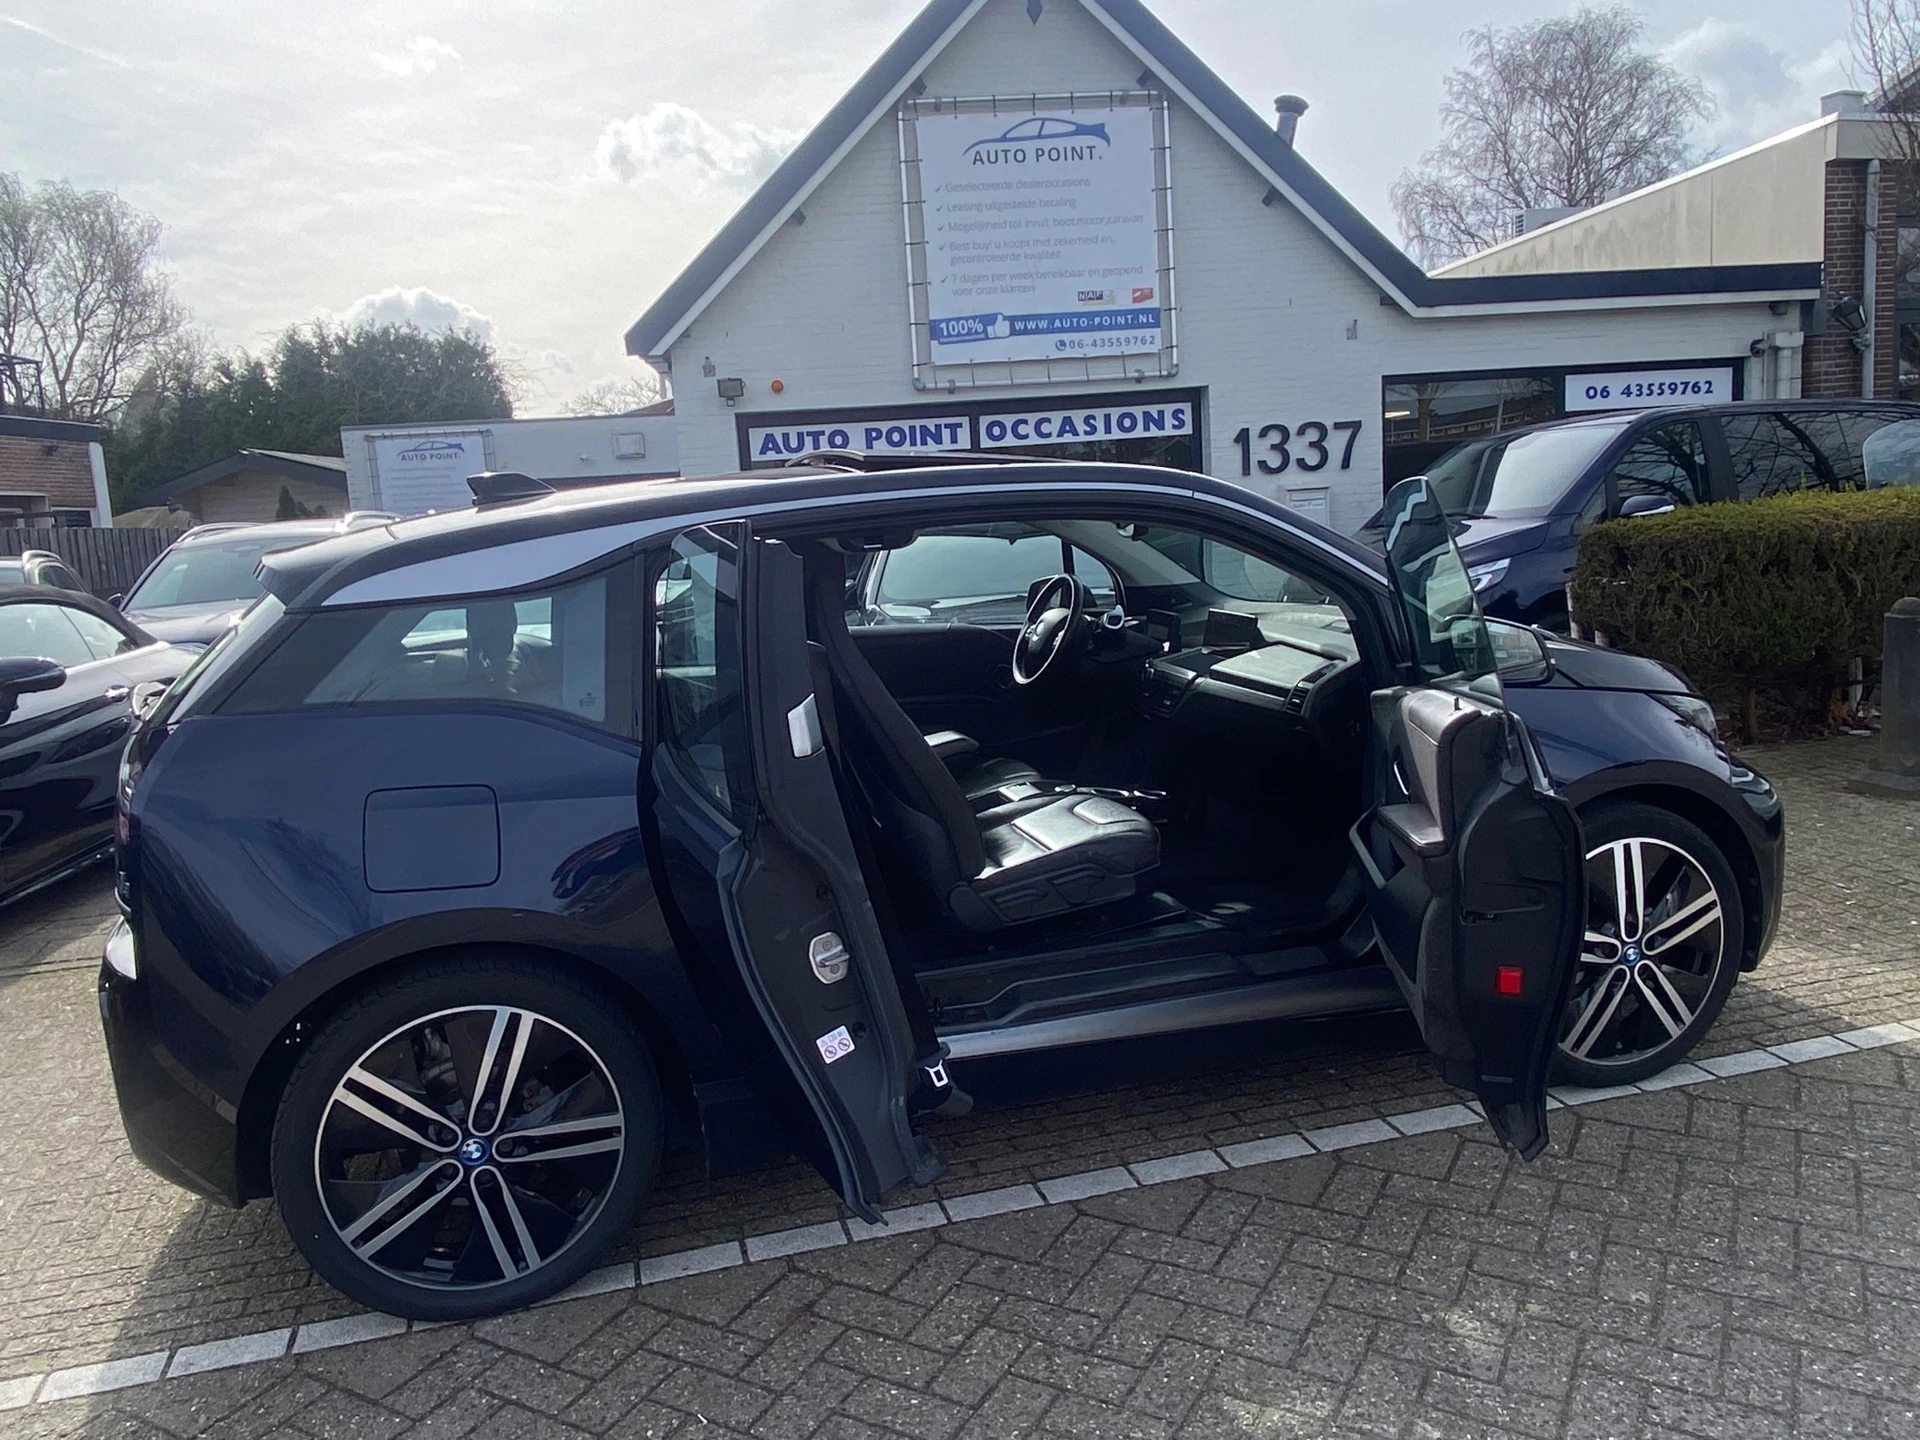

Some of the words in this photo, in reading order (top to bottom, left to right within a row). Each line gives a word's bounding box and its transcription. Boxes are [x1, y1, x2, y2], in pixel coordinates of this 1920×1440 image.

[972, 148, 1027, 165] AUTO
[945, 180, 1013, 193] Geselecteerde
[1015, 177, 1091, 191] dealeroccasions
[1039, 197, 1077, 210] betaling
[948, 219, 1007, 234] Mogelijkheid
[1008, 219, 1022, 229] tot
[950, 240, 970, 252] Best
[994, 240, 1001, 249] u
[1003, 237, 1030, 250] koopt
[1032, 237, 1052, 248] met
[1053, 234, 1099, 247] zekerheid
[950, 252, 1022, 267] gecontroleerde
[1023, 249, 1062, 261] kwaliteit
[951, 273, 957, 284] 7
[959, 272, 990, 285] dagen
[991, 272, 1008, 284] per
[1009, 270, 1035, 282] week
[1036, 267, 1086, 280] bereikbaar
[1087, 268, 1101, 278] en
[1102, 264, 1144, 279] geopend
[951, 287, 974, 297] voor
[975, 286, 999, 296] onze
[999, 284, 1036, 294] klanten
[939, 318, 984, 336] 100%
[1014, 314, 1155, 331] WWW.AUTO-POINT.NL
[1068, 335, 1156, 350] 06-43559762
[1585, 385, 1611, 400] 06
[1620, 380, 1714, 398] 43559762
[985, 408, 1187, 442] OCCASIONS
[758, 428, 850, 456] AUTO
[864, 422, 964, 450] POINT
[1233, 419, 1363, 477] 1337
[401, 453, 426, 461] AUTO
